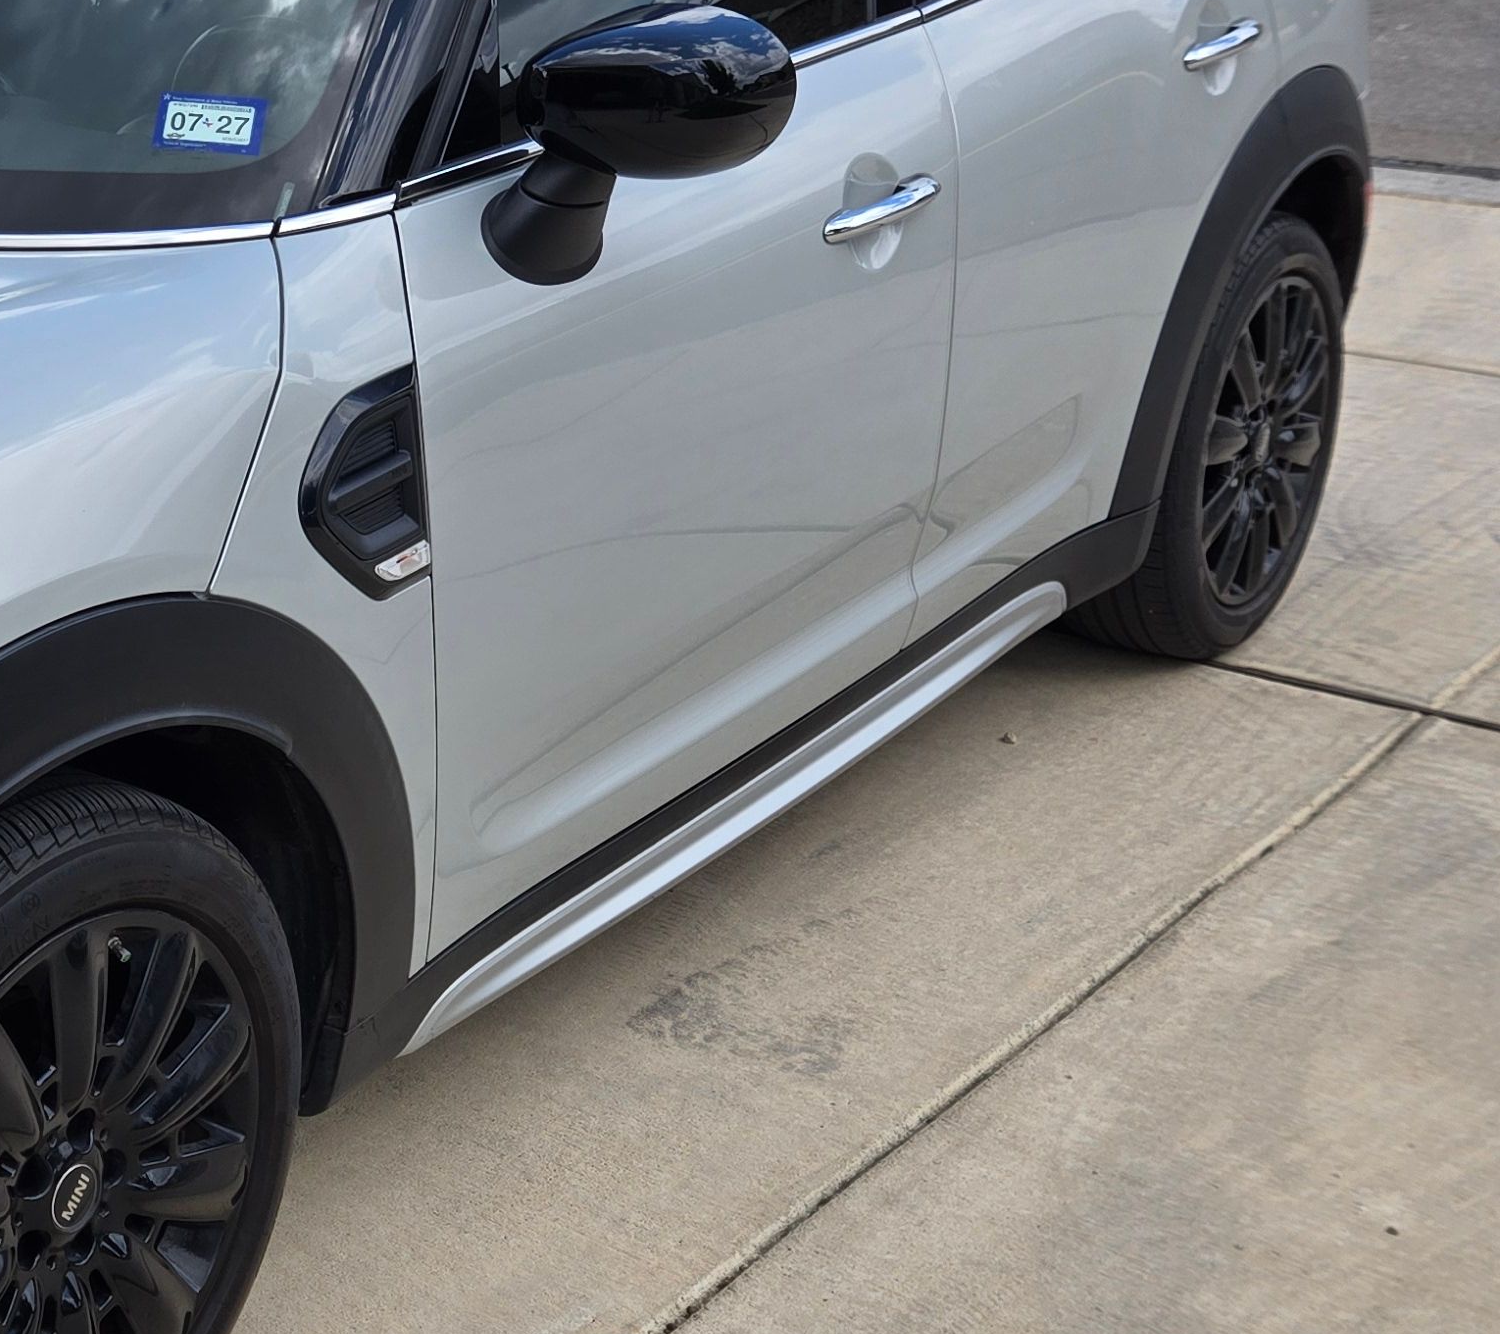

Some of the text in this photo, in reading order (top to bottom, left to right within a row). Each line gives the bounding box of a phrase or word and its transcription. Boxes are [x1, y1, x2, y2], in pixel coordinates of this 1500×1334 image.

[170, 112, 250, 135] 07 27
[61, 1173, 90, 1221] MINI
